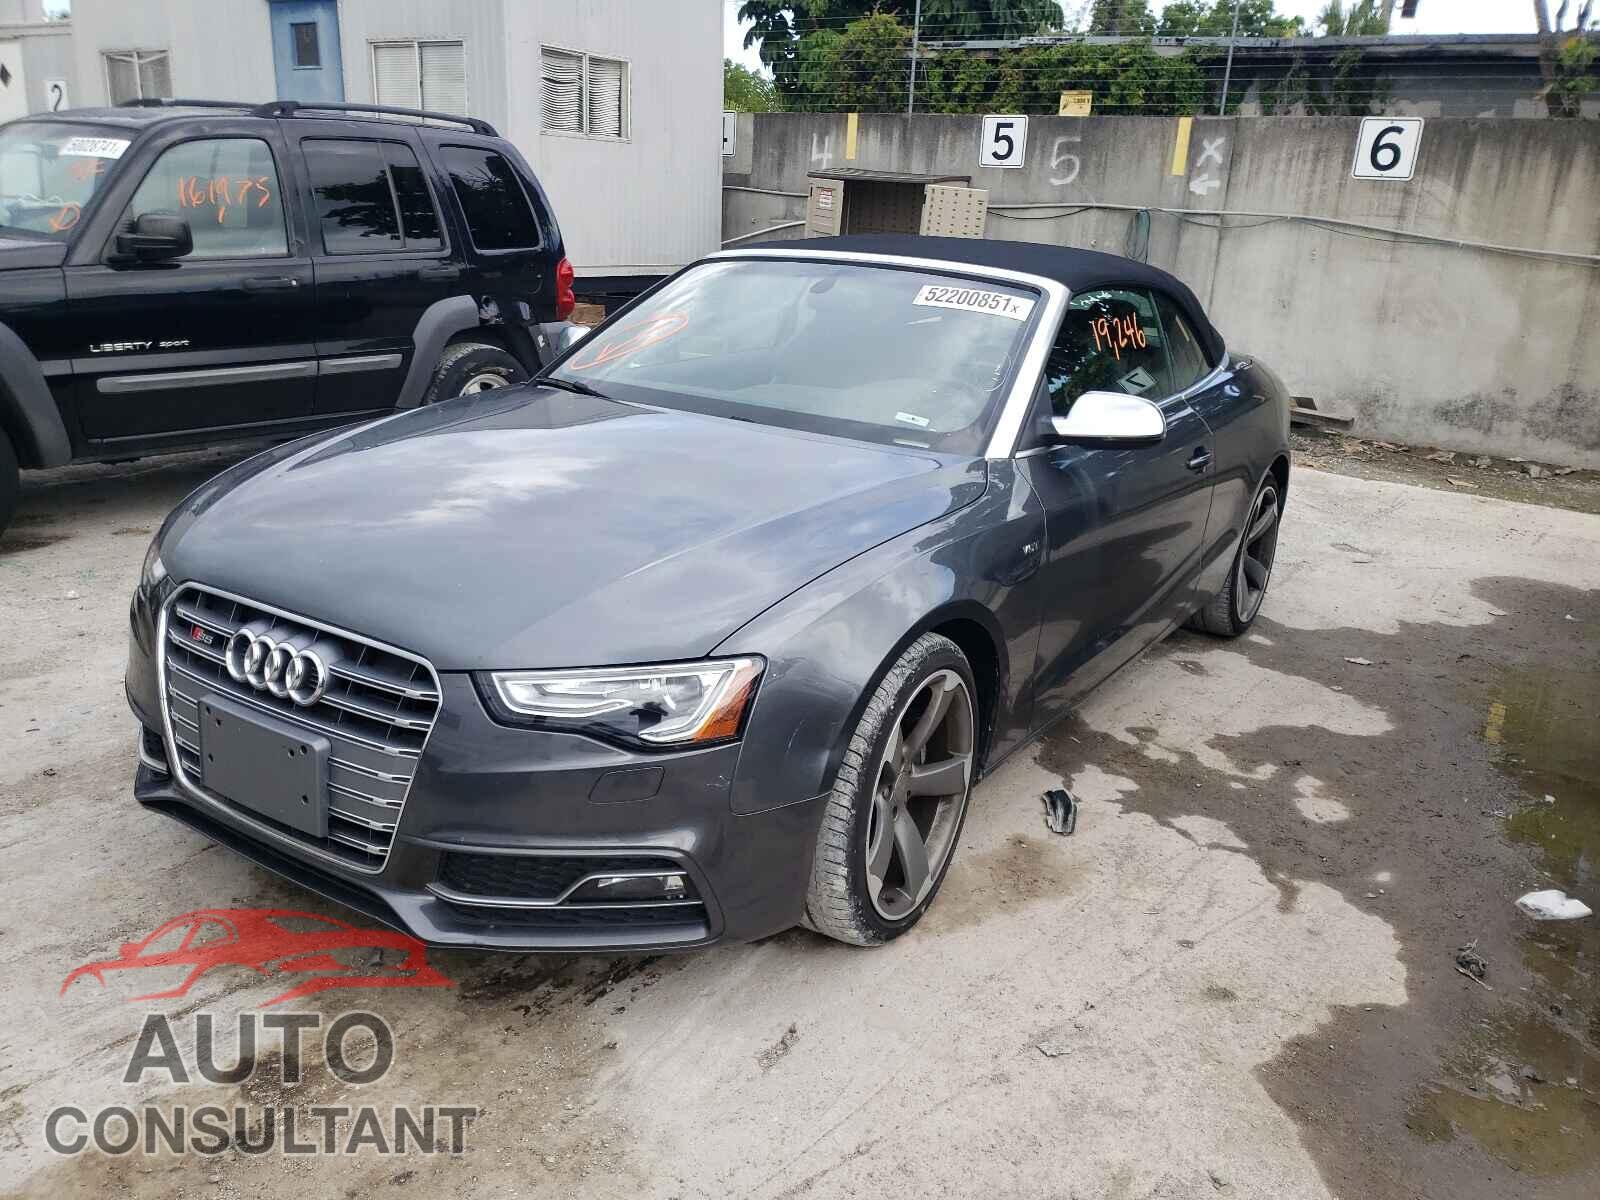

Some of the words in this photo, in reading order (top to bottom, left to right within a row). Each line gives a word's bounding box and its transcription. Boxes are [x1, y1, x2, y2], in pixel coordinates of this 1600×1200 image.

[811, 133, 832, 170] 4
[992, 122, 1014, 160] 5
[1370, 125, 1404, 171] 6
[1049, 136, 1081, 185] 5
[89, 341, 153, 353] LIBERTY
